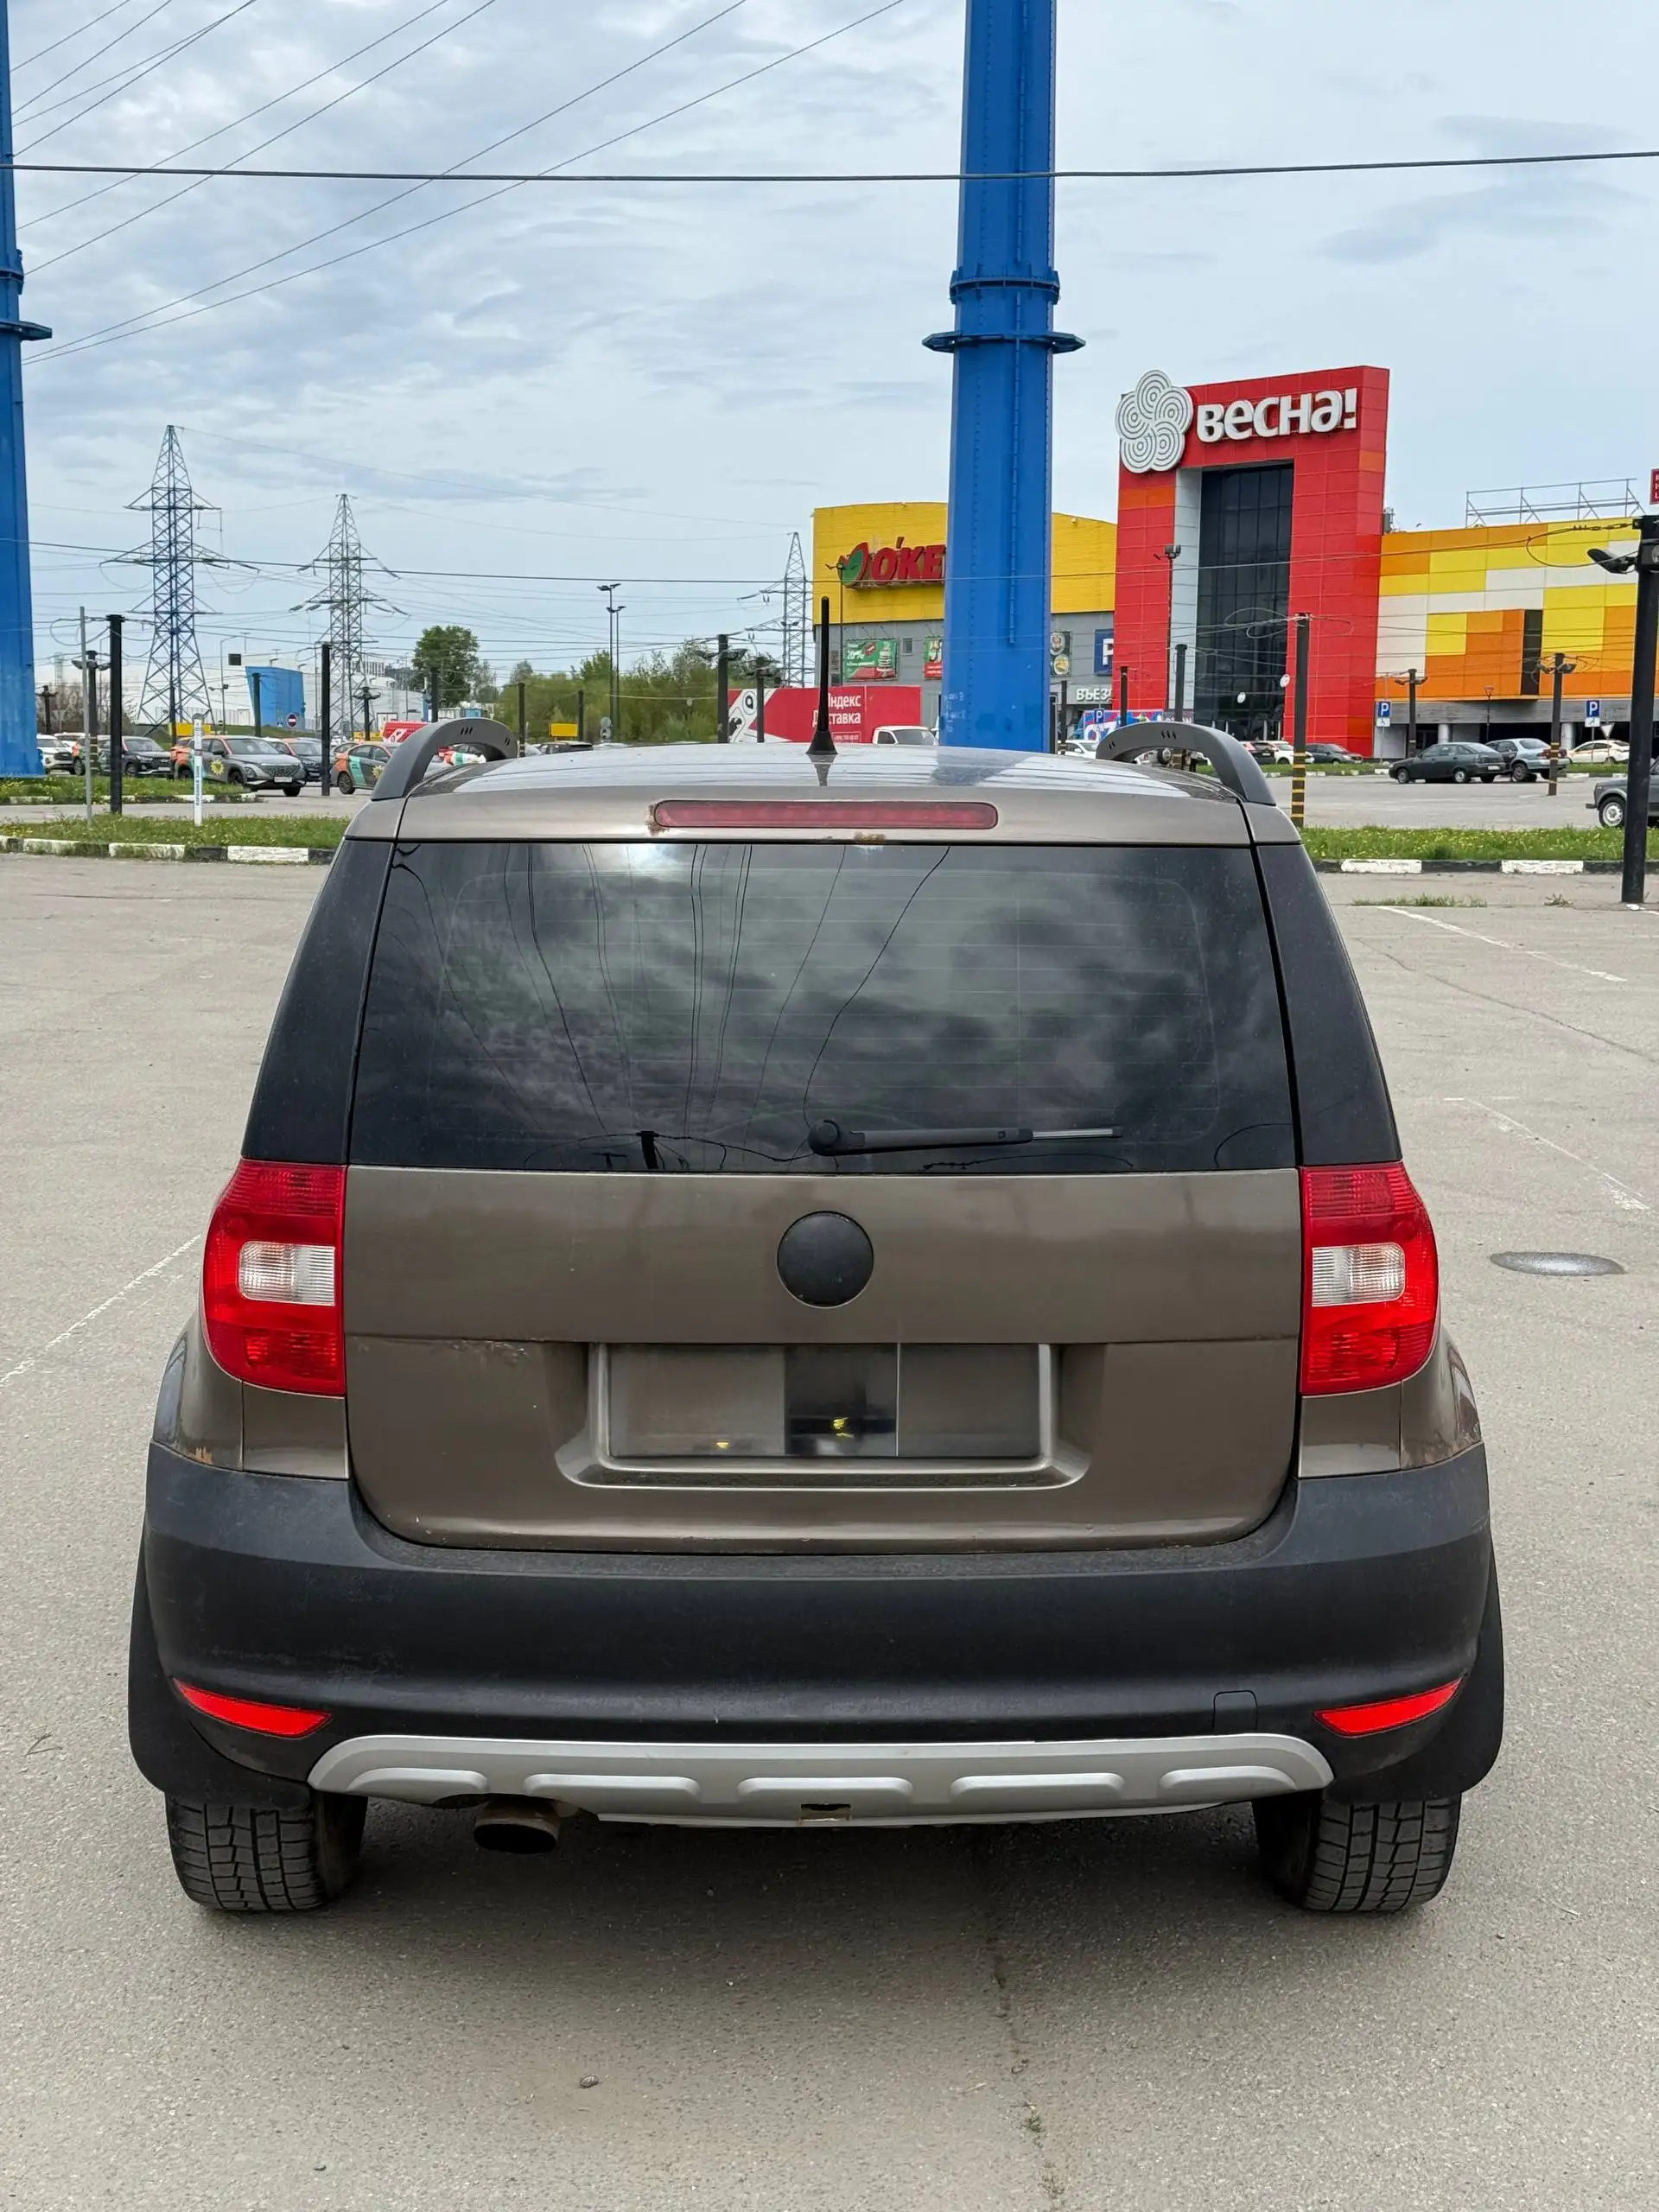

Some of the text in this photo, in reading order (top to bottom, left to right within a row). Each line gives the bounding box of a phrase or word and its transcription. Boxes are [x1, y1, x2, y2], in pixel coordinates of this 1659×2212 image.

[871, 536, 946, 585] О'КЕ
[827, 694, 861, 709] ндекс
[1381, 702, 1389, 716] P
[1589, 701, 1598, 716] P
[812, 709, 861, 728] Дставка
[1096, 710, 1103, 722] P
